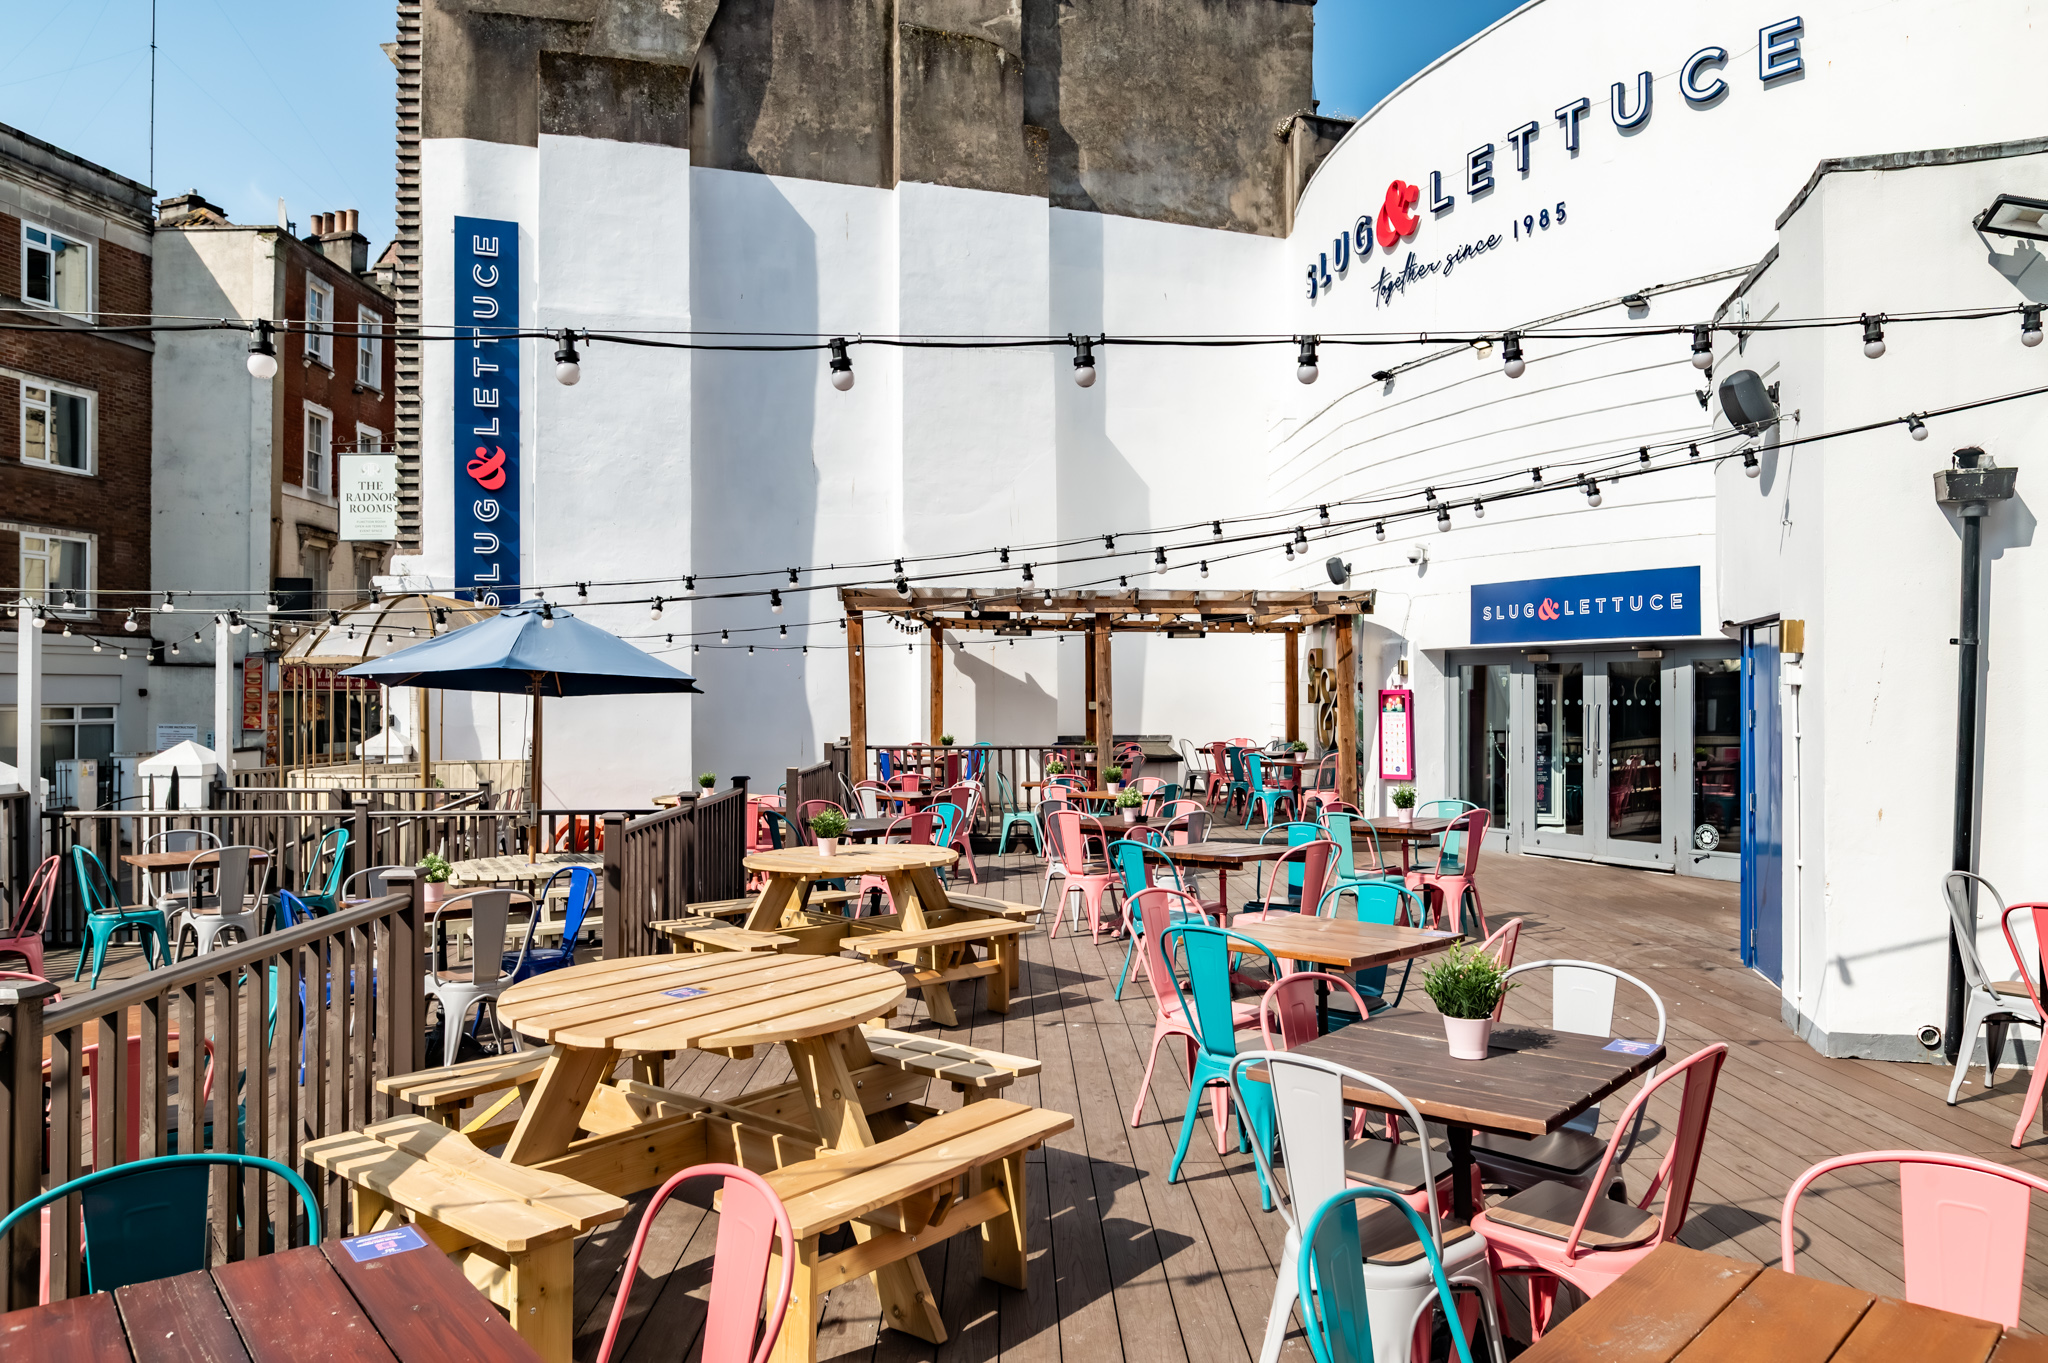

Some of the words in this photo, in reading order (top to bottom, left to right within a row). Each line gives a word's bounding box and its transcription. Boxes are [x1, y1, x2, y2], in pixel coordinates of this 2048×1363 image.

[1371, 252, 1441, 308] together
[1443, 233, 1502, 275] since
[1513, 201, 1566, 239] 1985
[357, 481, 384, 491] THE
[346, 492, 396, 502] RADNOR
[349, 504, 393, 513] ROOMS
